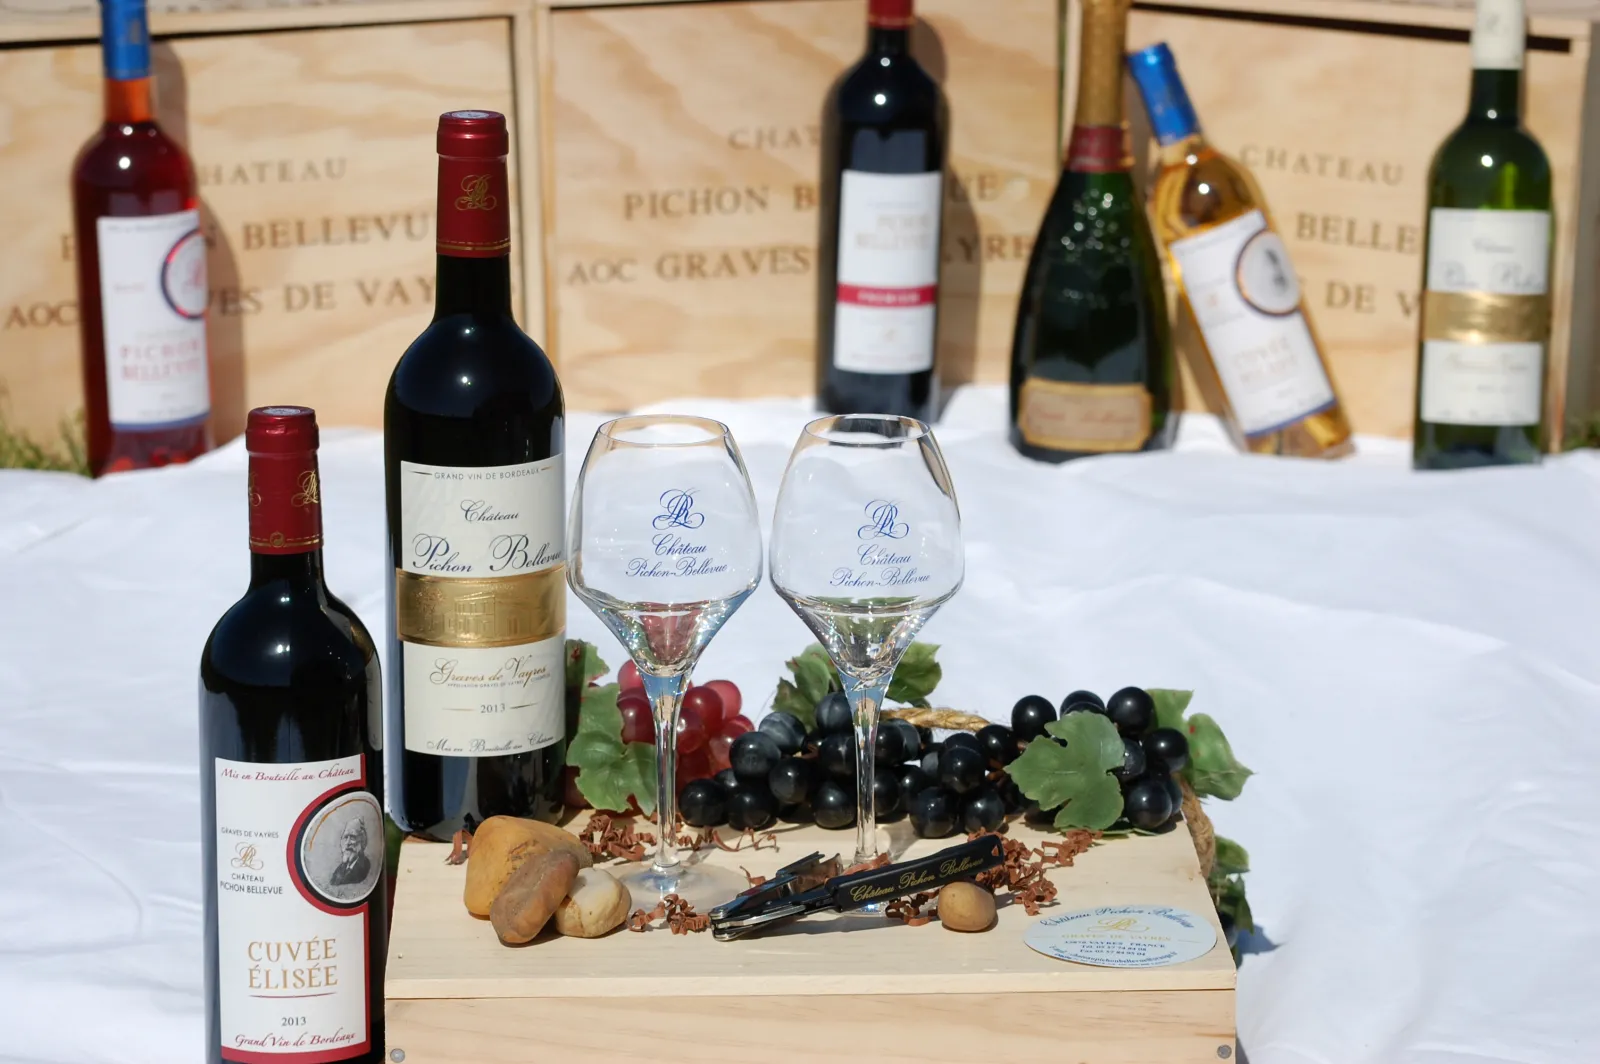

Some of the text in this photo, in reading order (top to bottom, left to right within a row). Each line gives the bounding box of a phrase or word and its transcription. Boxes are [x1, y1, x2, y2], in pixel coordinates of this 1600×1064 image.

[728, 126, 821, 152] CHAT
[200, 157, 348, 187] HATEAU
[623, 186, 771, 221] PICHON
[242, 213, 432, 252] BELLEVU
[1295, 210, 1420, 256] BELLE
[567, 259, 641, 288] AOC
[654, 245, 813, 283] GRAVES
[284, 282, 338, 314] DE
[1324, 280, 1377, 315] DE
[434, 468, 539, 480] GRAND VIN DE BORDEAUX
[459, 499, 519, 522] Château
[412, 533, 563, 572] Pichon Bellevue
[652, 533, 707, 556] Château
[857, 543, 911, 566] Château
[430, 654, 547, 688] Graves de Vayres
[480, 703, 506, 714] 2013
[221, 768, 239, 778] Mis
[255, 768, 302, 781] Bouteille
[318, 762, 356, 779] Château
[221, 826, 242, 837] GRAVES
[232, 872, 264, 882] CHÂTEAU
[898, 870, 936, 890] Pichon
[939, 857, 984, 878] Bellevue
[220, 880, 283, 894] PICHON BELLEVUE
[248, 936, 338, 962] CUVÉE
[248, 962, 338, 990] ÉLISÉE
[281, 1016, 307, 1027] 2013
[235, 1027, 356, 1048] Grand Vin de Bordeaux
